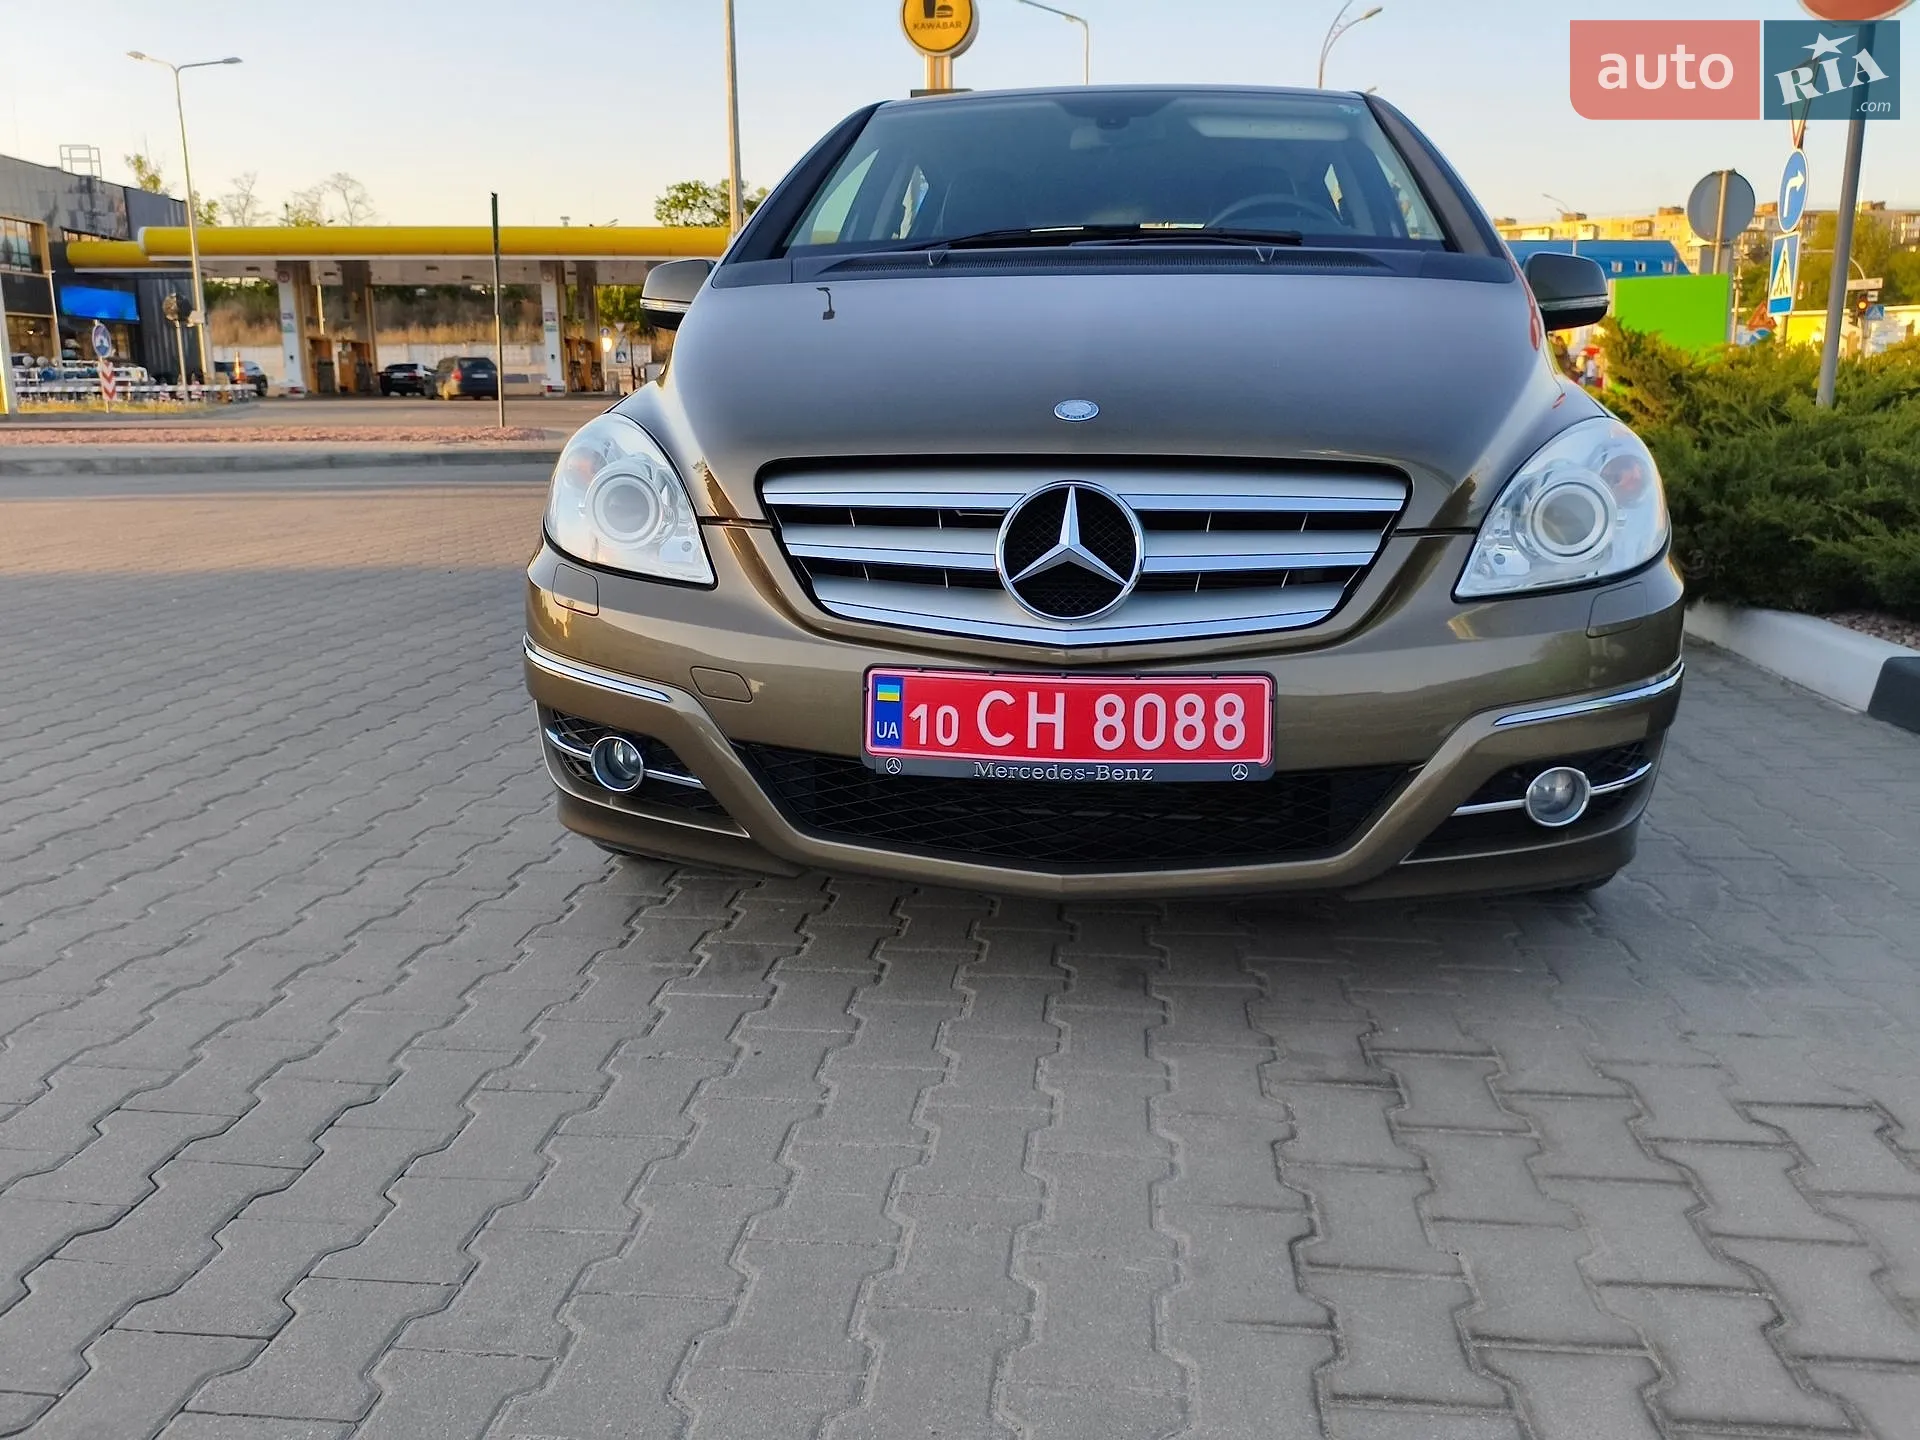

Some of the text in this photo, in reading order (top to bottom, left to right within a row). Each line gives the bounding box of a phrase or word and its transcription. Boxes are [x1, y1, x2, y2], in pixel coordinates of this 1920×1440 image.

[912, 21, 962, 30] KAWABAR
[909, 689, 1246, 751] 10 CH 8088
[876, 721, 899, 739] UA
[974, 761, 1153, 781] Mercedes-Benz
